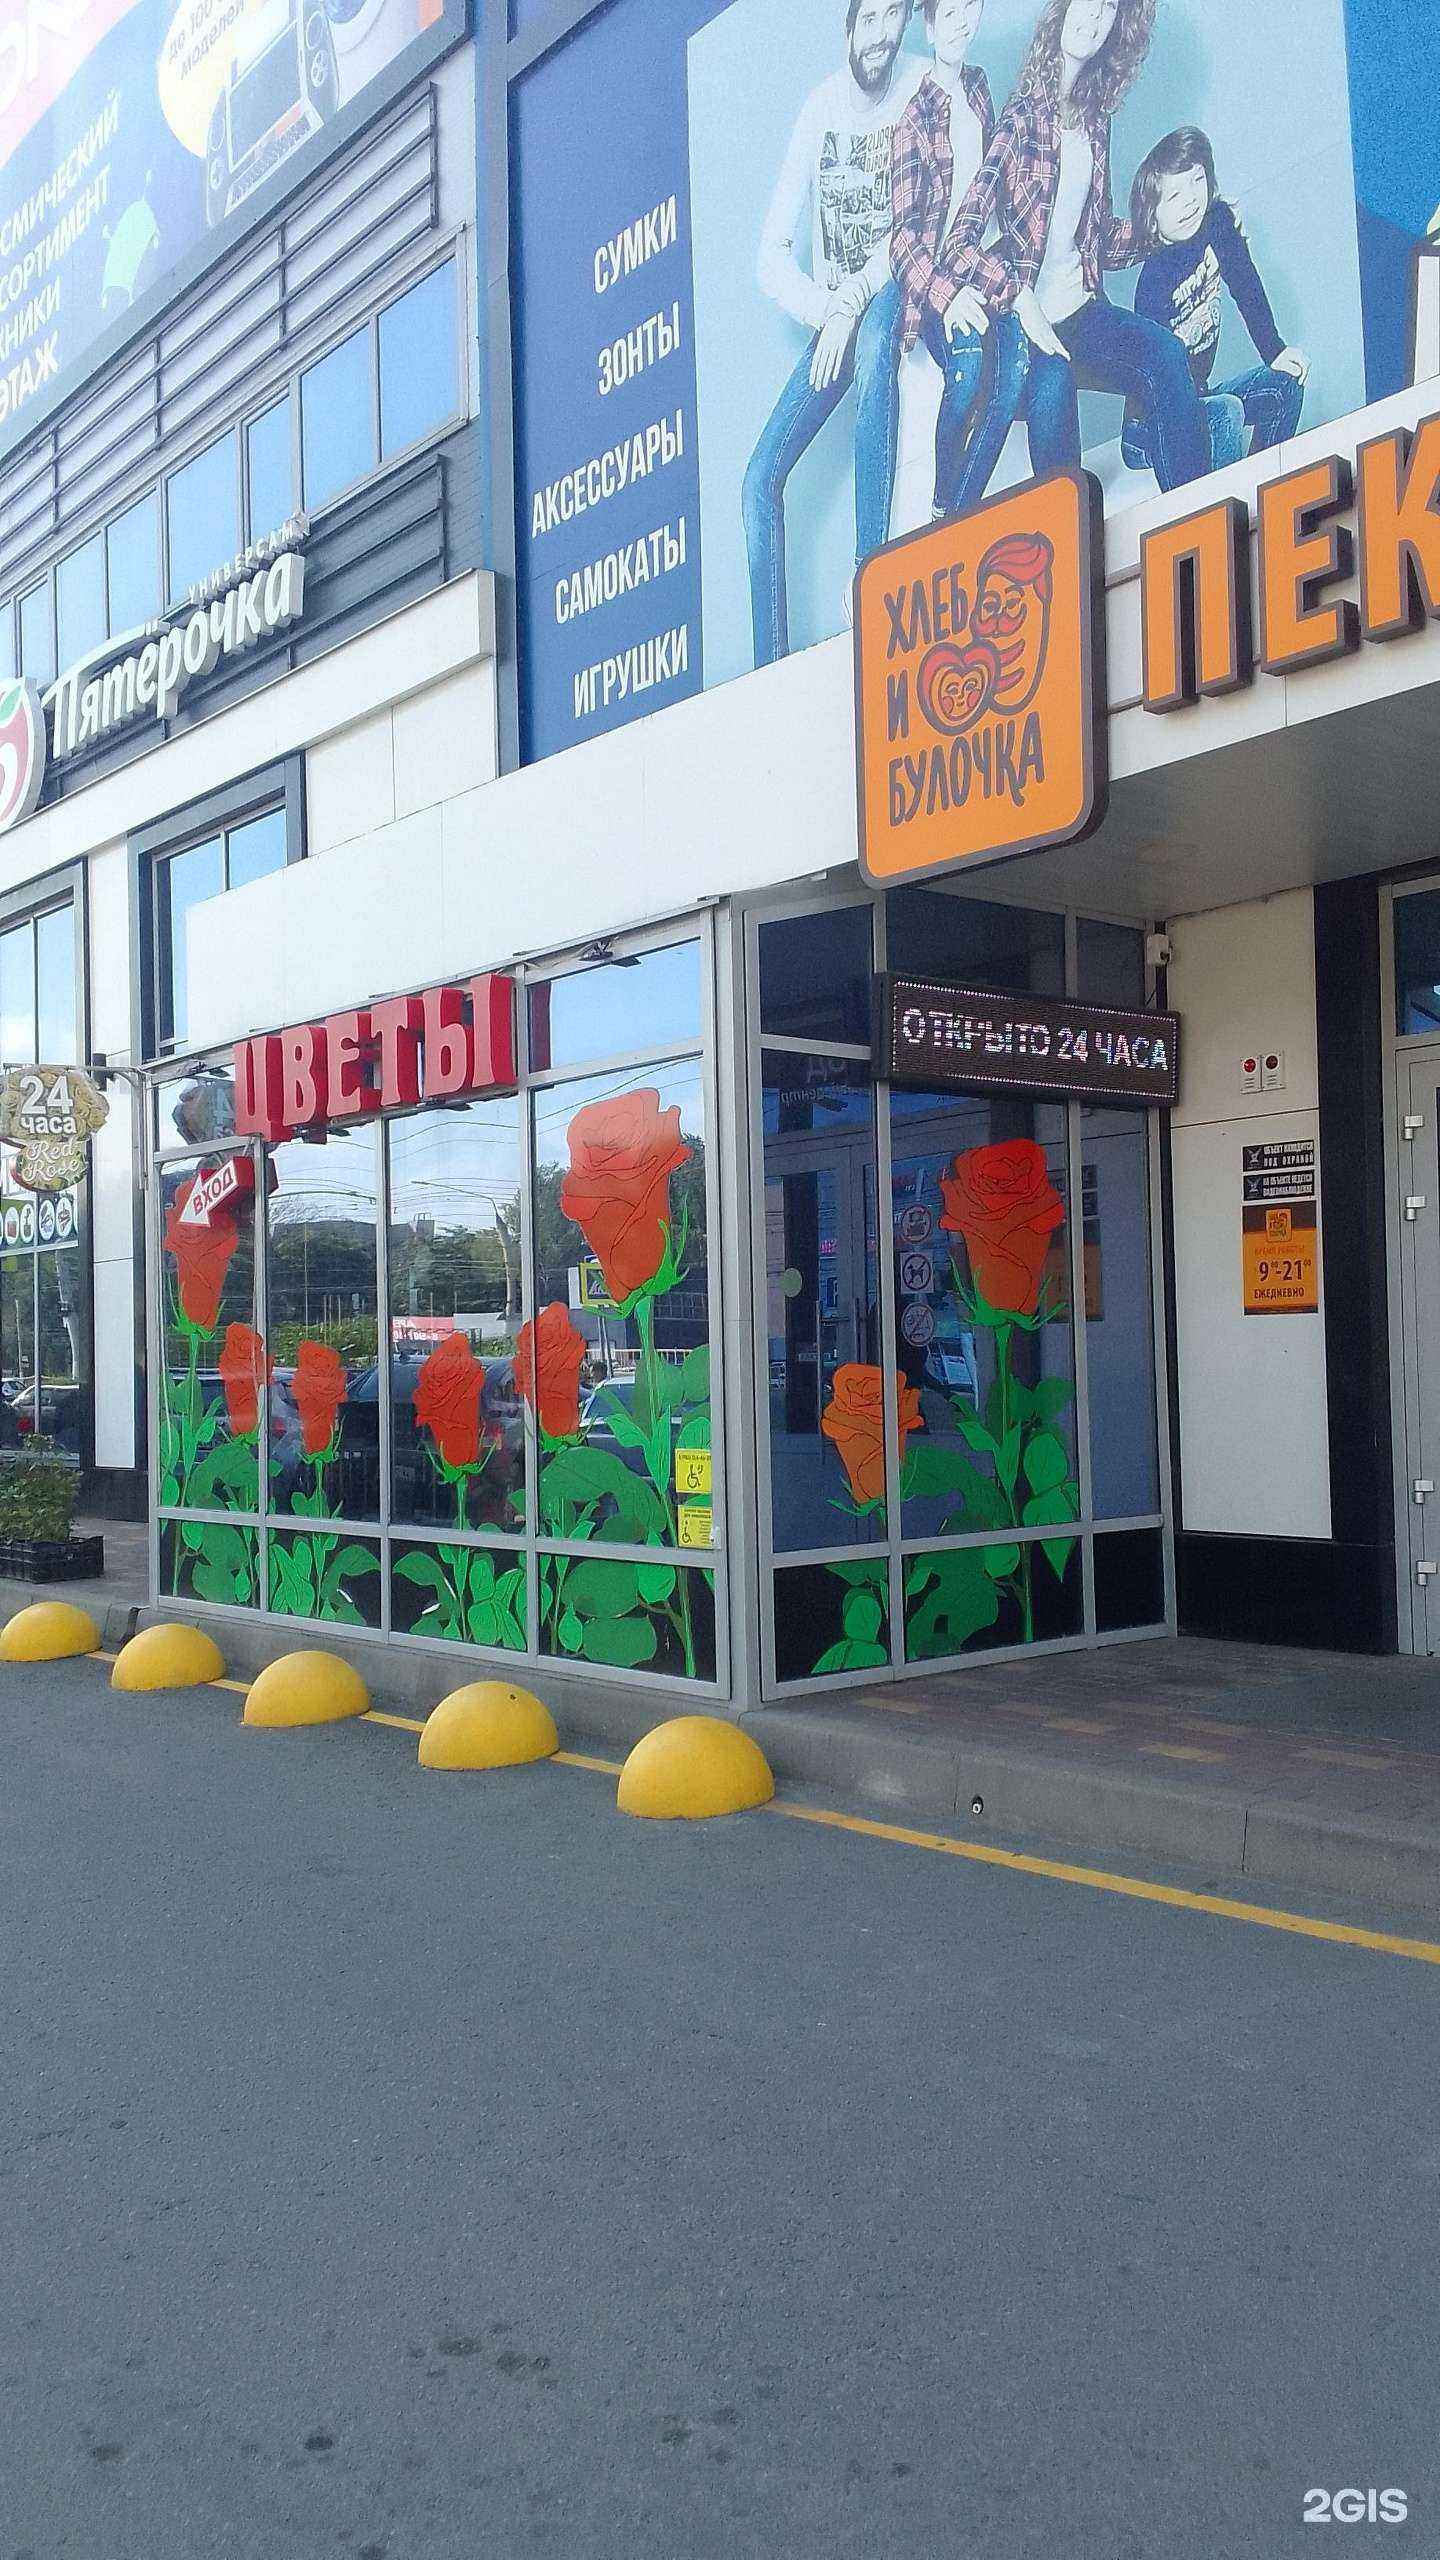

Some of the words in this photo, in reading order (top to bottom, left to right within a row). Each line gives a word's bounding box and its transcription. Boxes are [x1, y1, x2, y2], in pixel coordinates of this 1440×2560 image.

[594, 194, 678, 295] СУМКИ
[598, 301, 680, 396] ЗОНТЫ
[531, 409, 683, 539] АКСЕССУАРЫ
[555, 517, 687, 625] САМОКАТЫ
[883, 562, 969, 660] ХЛЕБ
[573, 624, 688, 719] ИГРУШКИ
[887, 669, 910, 742] И
[889, 713, 1046, 828] БУЛОЧКА
[234, 973, 517, 1143] ЦВЕТЫ
[902, 1008, 1051, 1056] ОТКРЫТО
[1057, 1027, 1089, 1063] 24
[1095, 1031, 1168, 1071] ЧАСА
[20, 1075, 74, 1115] 24
[20, 1116, 77, 1135] часа
[22, 1158, 80, 1181] Rose
[26, 1136, 78, 1164] Red
[193, 1166, 234, 1215] ВХОД
